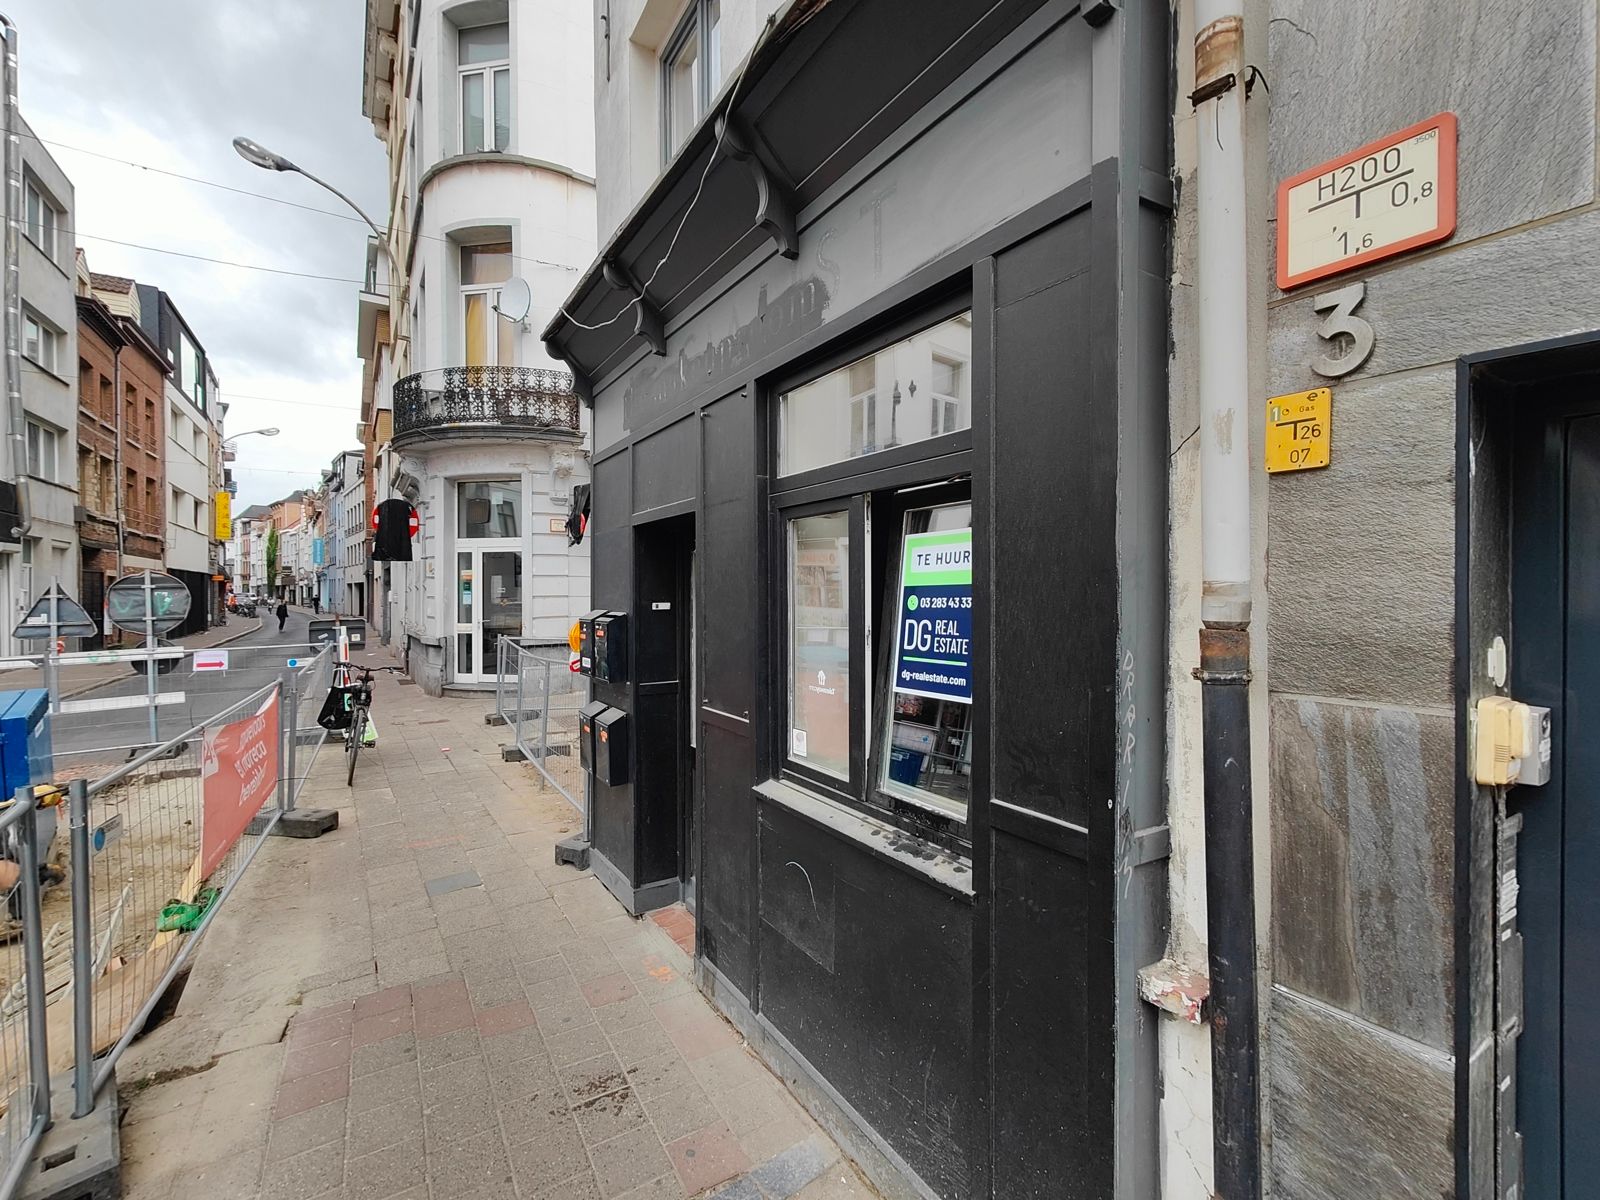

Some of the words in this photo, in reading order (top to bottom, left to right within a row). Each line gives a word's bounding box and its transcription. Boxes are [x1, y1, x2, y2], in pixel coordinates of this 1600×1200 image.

[1318, 147, 1401, 201] H200
[1391, 181, 1433, 207] 0,8
[1337, 232, 1373, 256] 1,6
[1311, 282, 1375, 377] 3
[1299, 405, 1315, 413] Gas
[917, 554, 931, 566] TE
[935, 550, 971, 565] HUUR
[920, 598, 931, 609] 03
[931, 598, 947, 609] 283
[948, 598, 960, 609] 43
[960, 597, 972, 609] 33
[903, 619, 932, 652] DG
[935, 620, 960, 636] REAL
[933, 637, 969, 655] ESTATE
[901, 669, 966, 686] dg-realestate.com
